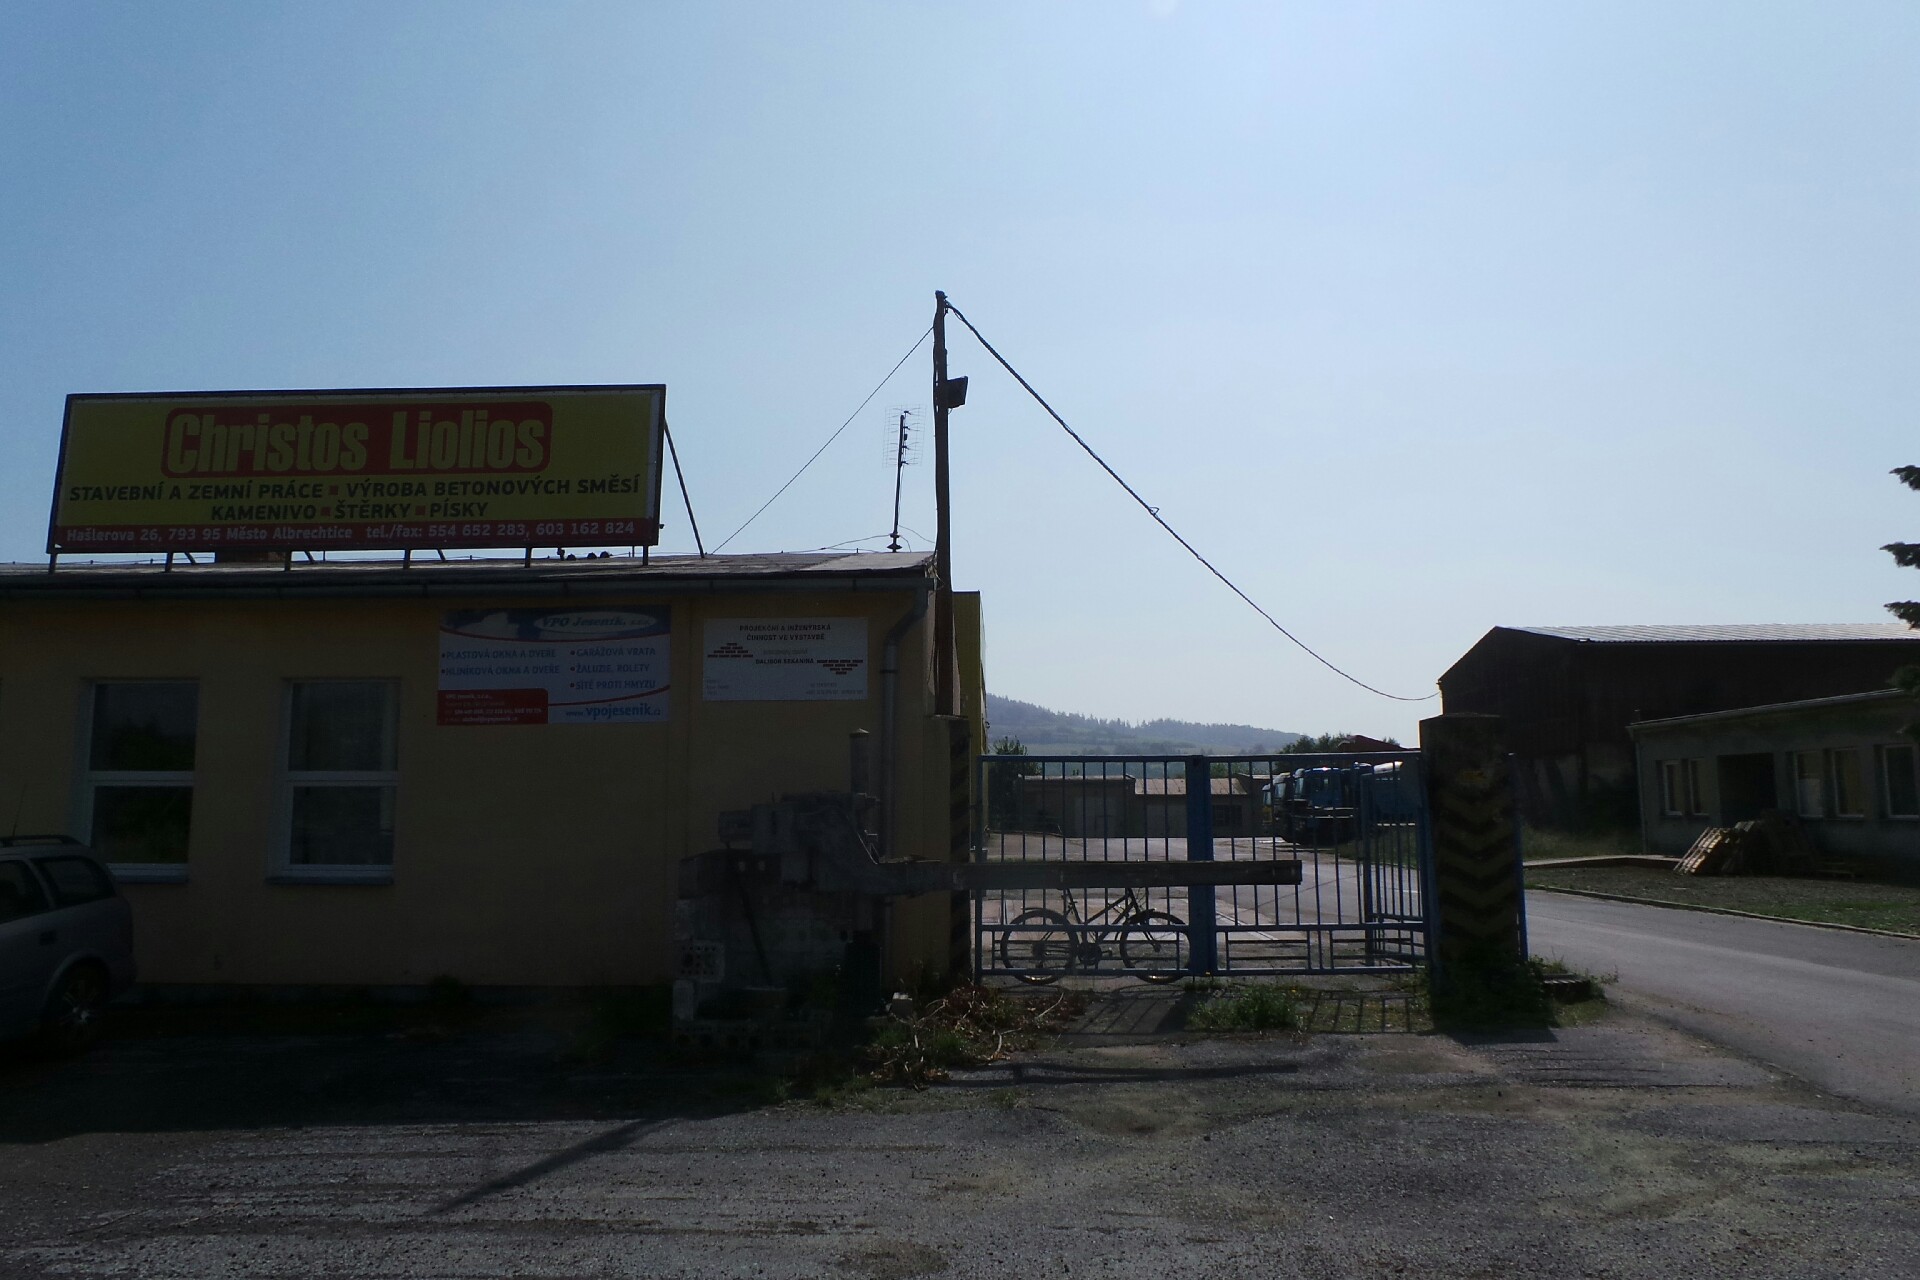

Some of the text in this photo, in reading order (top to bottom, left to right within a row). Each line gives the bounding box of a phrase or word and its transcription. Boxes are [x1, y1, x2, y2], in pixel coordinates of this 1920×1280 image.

[167, 408, 544, 473] Christos Liolios
[69, 473, 640, 501] STAVEBNÍ A ZEMNÍ PRÁCE VÝROBA BETONOVÝCH SMĚSÍ
[211, 497, 489, 521] KAMENIVO ŠTĚRKY PÍSKY
[67, 522, 635, 543] Hašlerova 26, 793 95 Město Albrechtice tel./fax: 554 652 283, 603 162 824
[739, 624, 778, 632] PROJEKČNÍ
[746, 633, 777, 641] ČINNOST
[446, 648, 557, 660] PLASTOVÁ OKNA A DVEŘE
[576, 646, 656, 657] GARÁŽOVÁ VRATA
[446, 665, 560, 676] HLINÍKOVÁ OKNA A DVEŘE
[616, 664, 650, 673] ROLETY
[596, 681, 622, 690] PROTI
[624, 680, 656, 689] HMYZU
